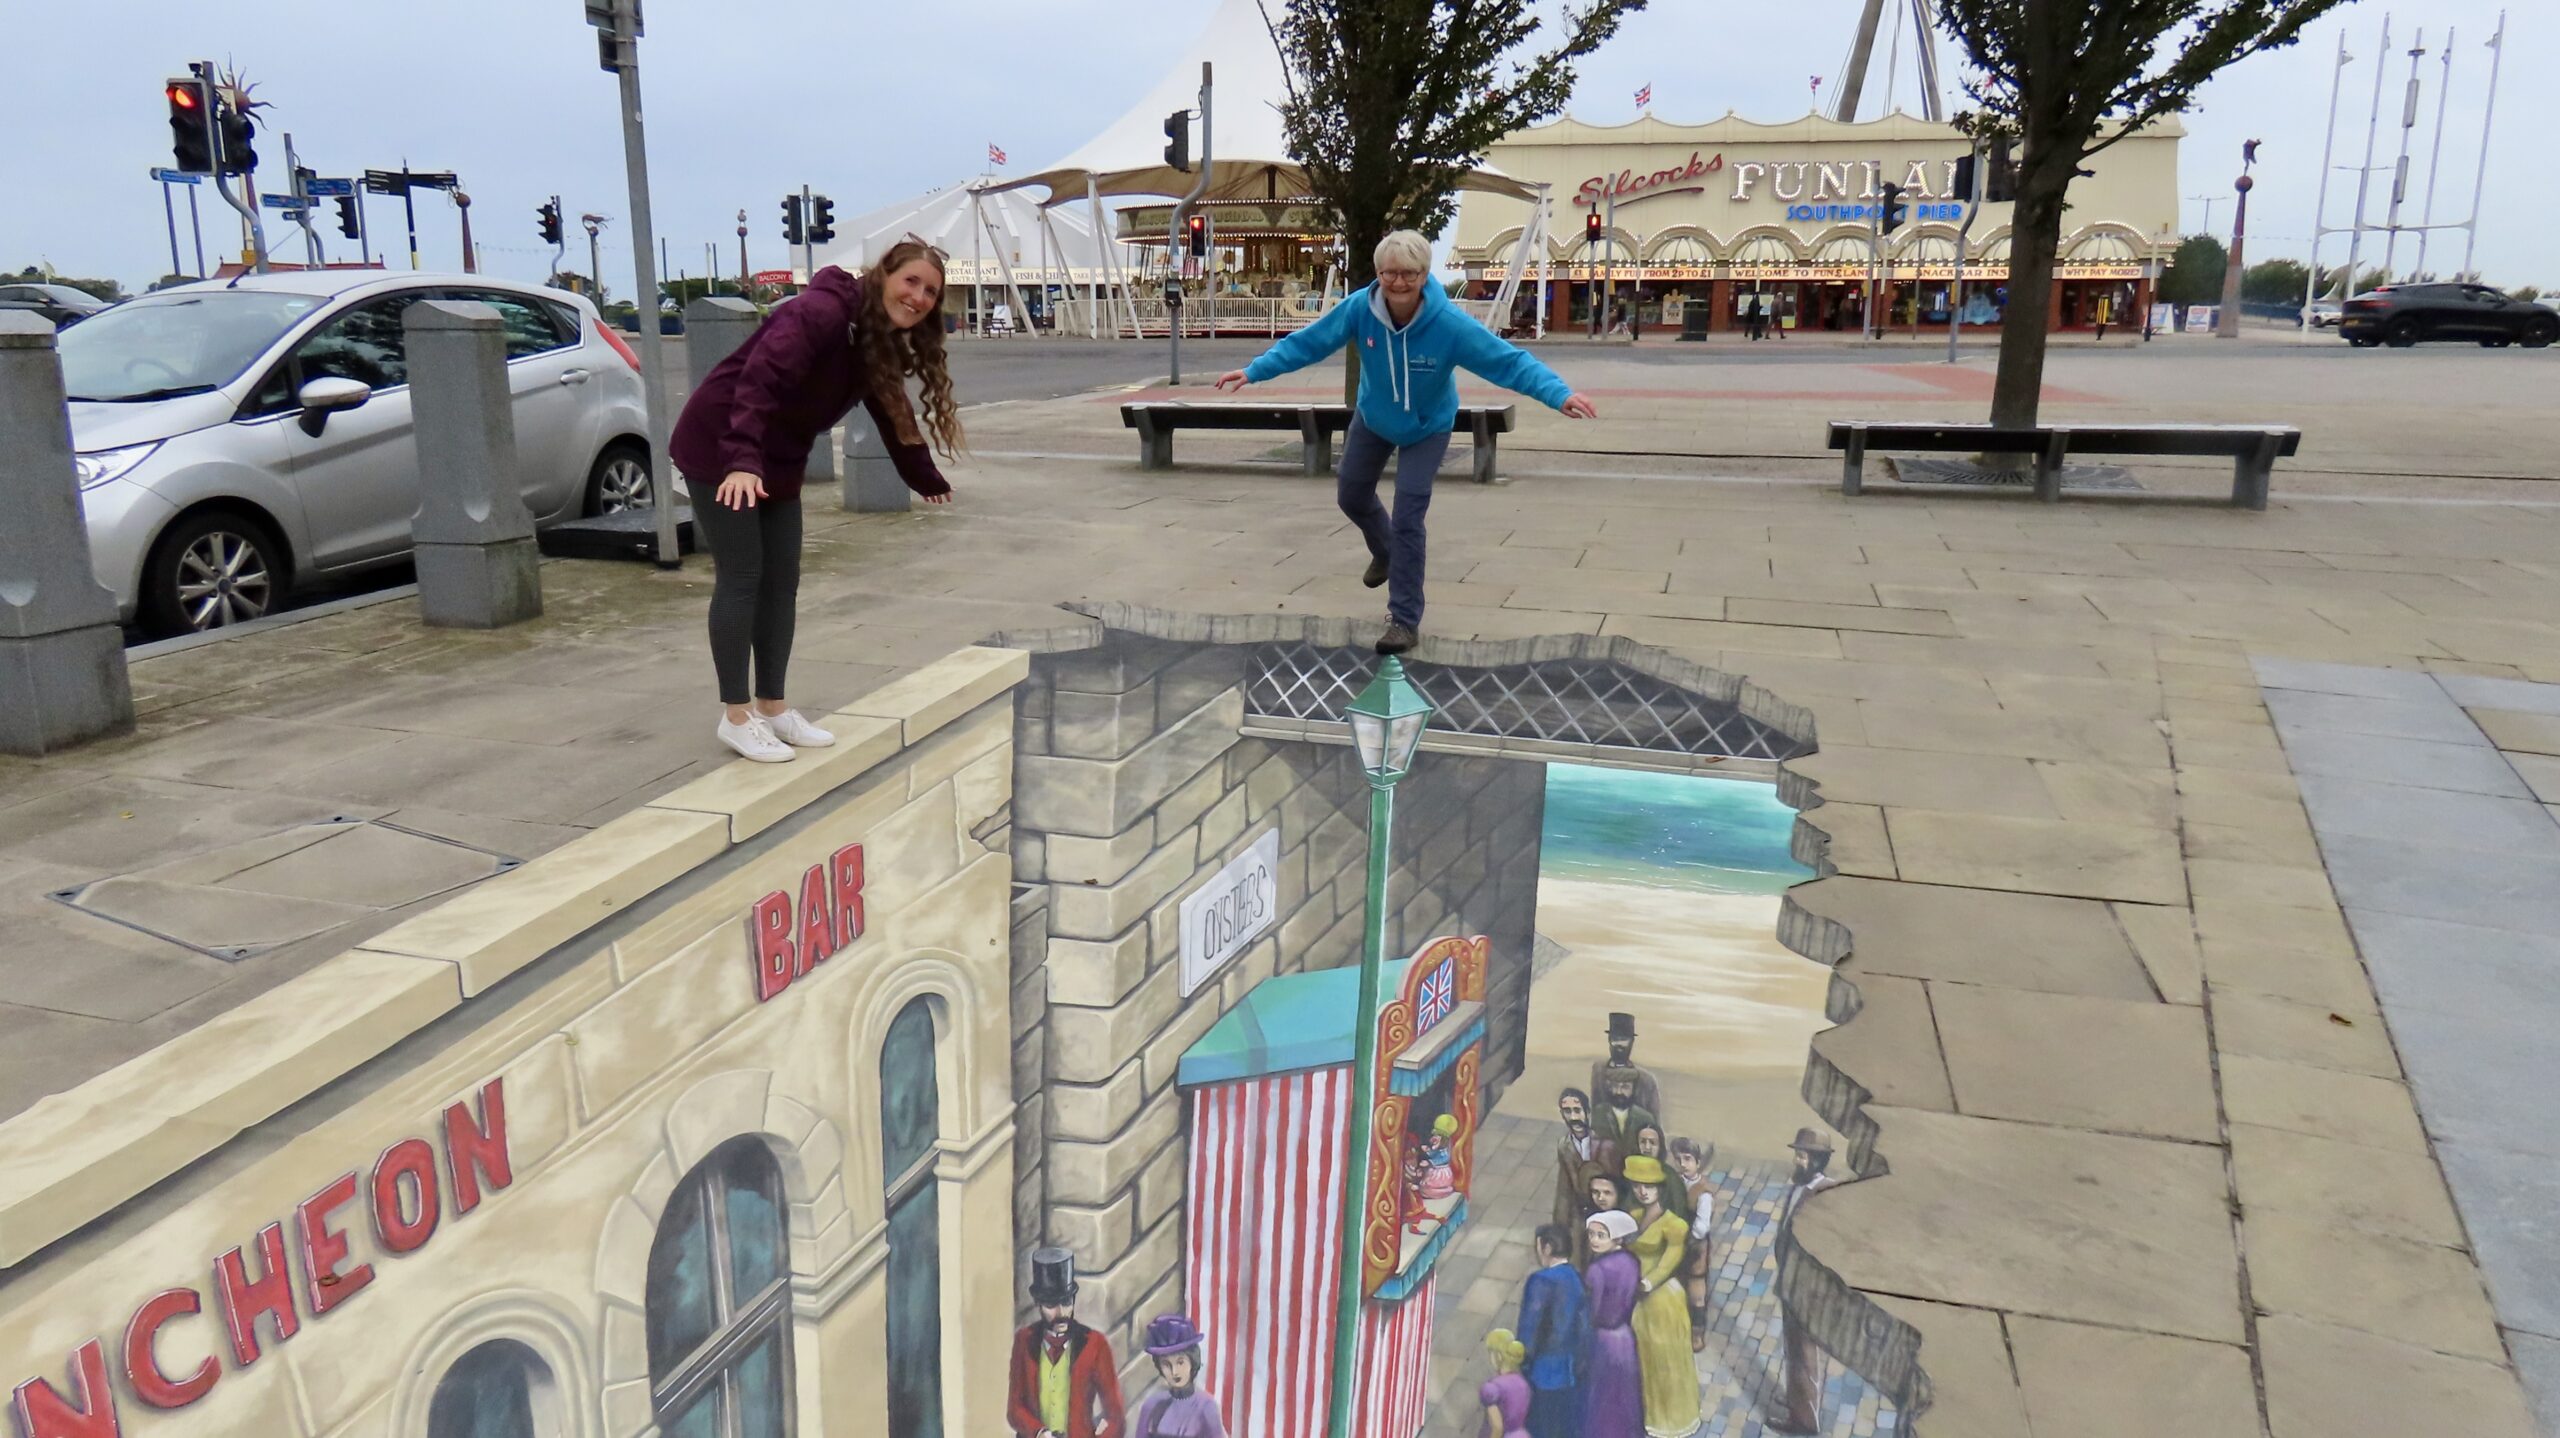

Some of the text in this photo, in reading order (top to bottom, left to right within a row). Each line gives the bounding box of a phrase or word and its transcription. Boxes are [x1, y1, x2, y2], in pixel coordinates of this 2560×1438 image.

[1573, 151, 1723, 206] Silcocks
[1786, 204, 1962, 221] SOUTHPOT PIER
[945, 267, 998, 276] RESTAUANT
[1015, 272, 1034, 280] FISH
[1035, 272, 1042, 280] &
[1485, 270, 1506, 278] FREE
[1644, 269, 1670, 278] FROM
[1685, 269, 1699, 278] TO
[1699, 269, 1712, 278] £1
[1734, 269, 1789, 278] WELCOME
[1795, 269, 1809, 277] TO
[2065, 268, 2087, 277] WHY
[2089, 268, 2109, 277] PAY
[758, 273, 787, 282] BALCONY
[1203, 864, 1267, 960] OYSTERS
[13, 843, 865, 1438] NCHEON BAR
